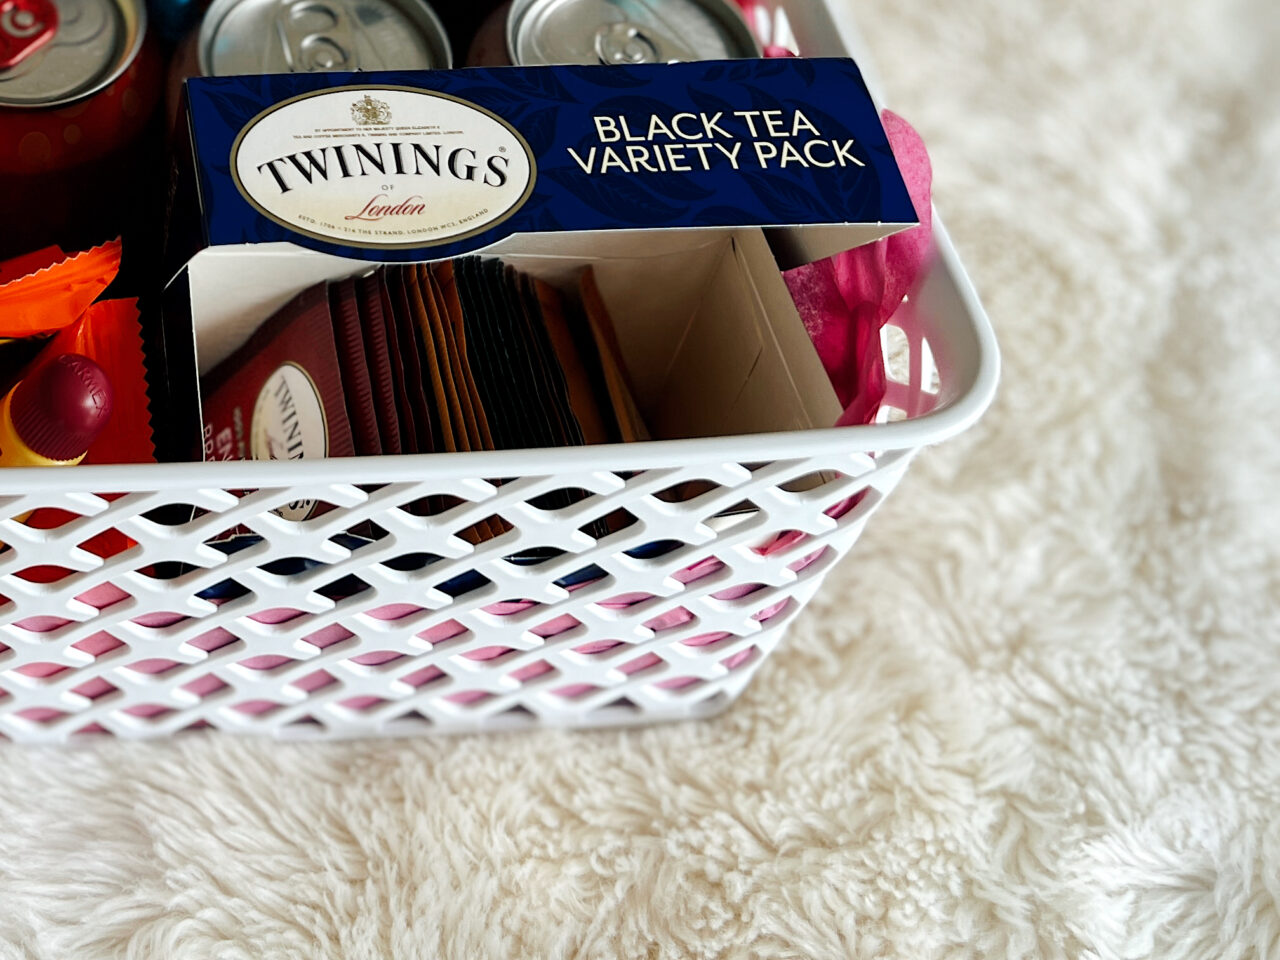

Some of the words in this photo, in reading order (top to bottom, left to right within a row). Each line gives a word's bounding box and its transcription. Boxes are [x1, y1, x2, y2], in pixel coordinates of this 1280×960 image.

[593, 112, 733, 142] BLACK
[733, 109, 821, 138] TEA
[257, 142, 510, 194] TWININGS
[566, 142, 742, 175] VARIETY
[753, 139, 866, 169] PACK
[344, 193, 426, 222] London
[407, 225, 439, 235] LONDON
[458, 208, 489, 225] ENGLAND
